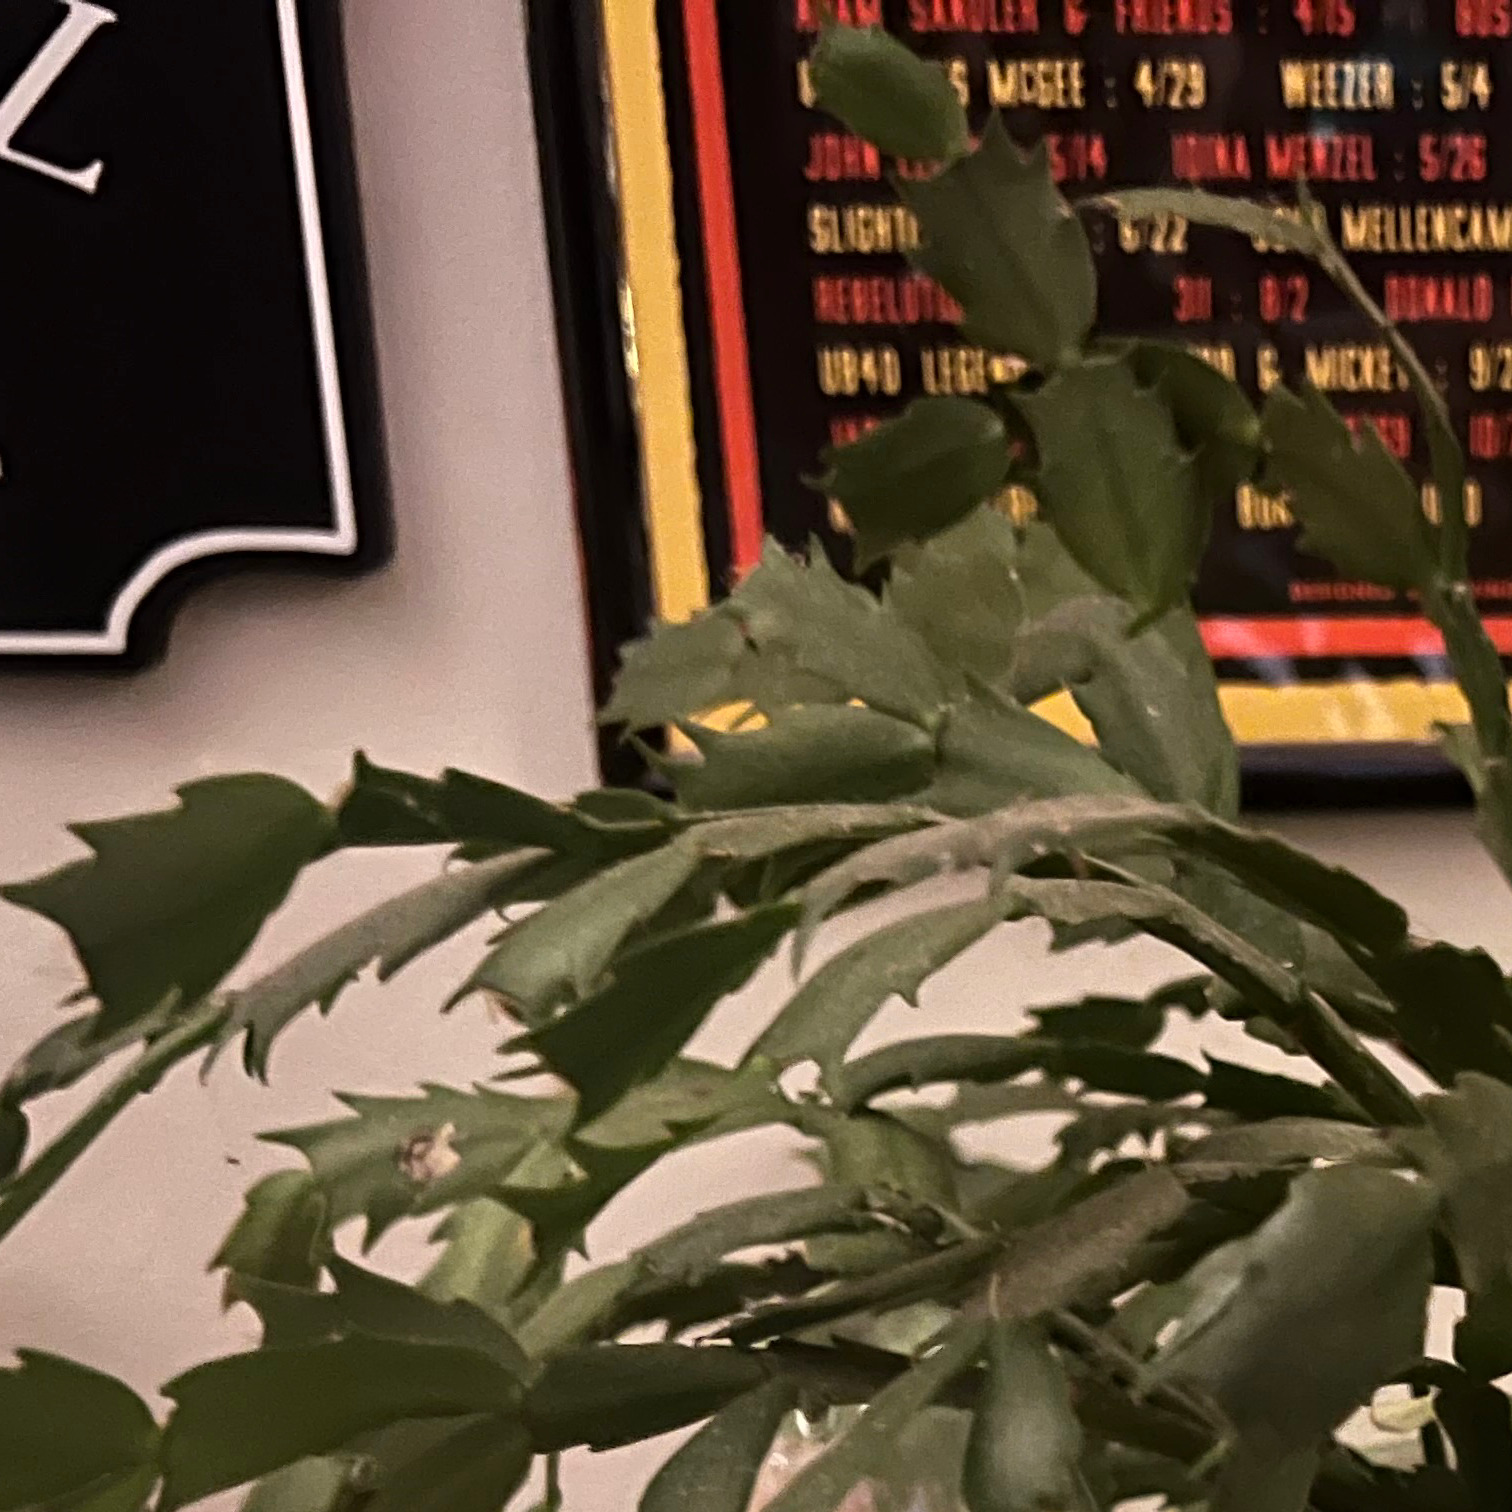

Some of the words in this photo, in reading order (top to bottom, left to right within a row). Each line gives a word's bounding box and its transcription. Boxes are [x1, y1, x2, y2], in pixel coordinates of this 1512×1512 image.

[1279, 59, 1394, 110] WEEZER
[1439, 59, 1492, 110] 5/4
[1385, 274, 1493, 323] DONALD
